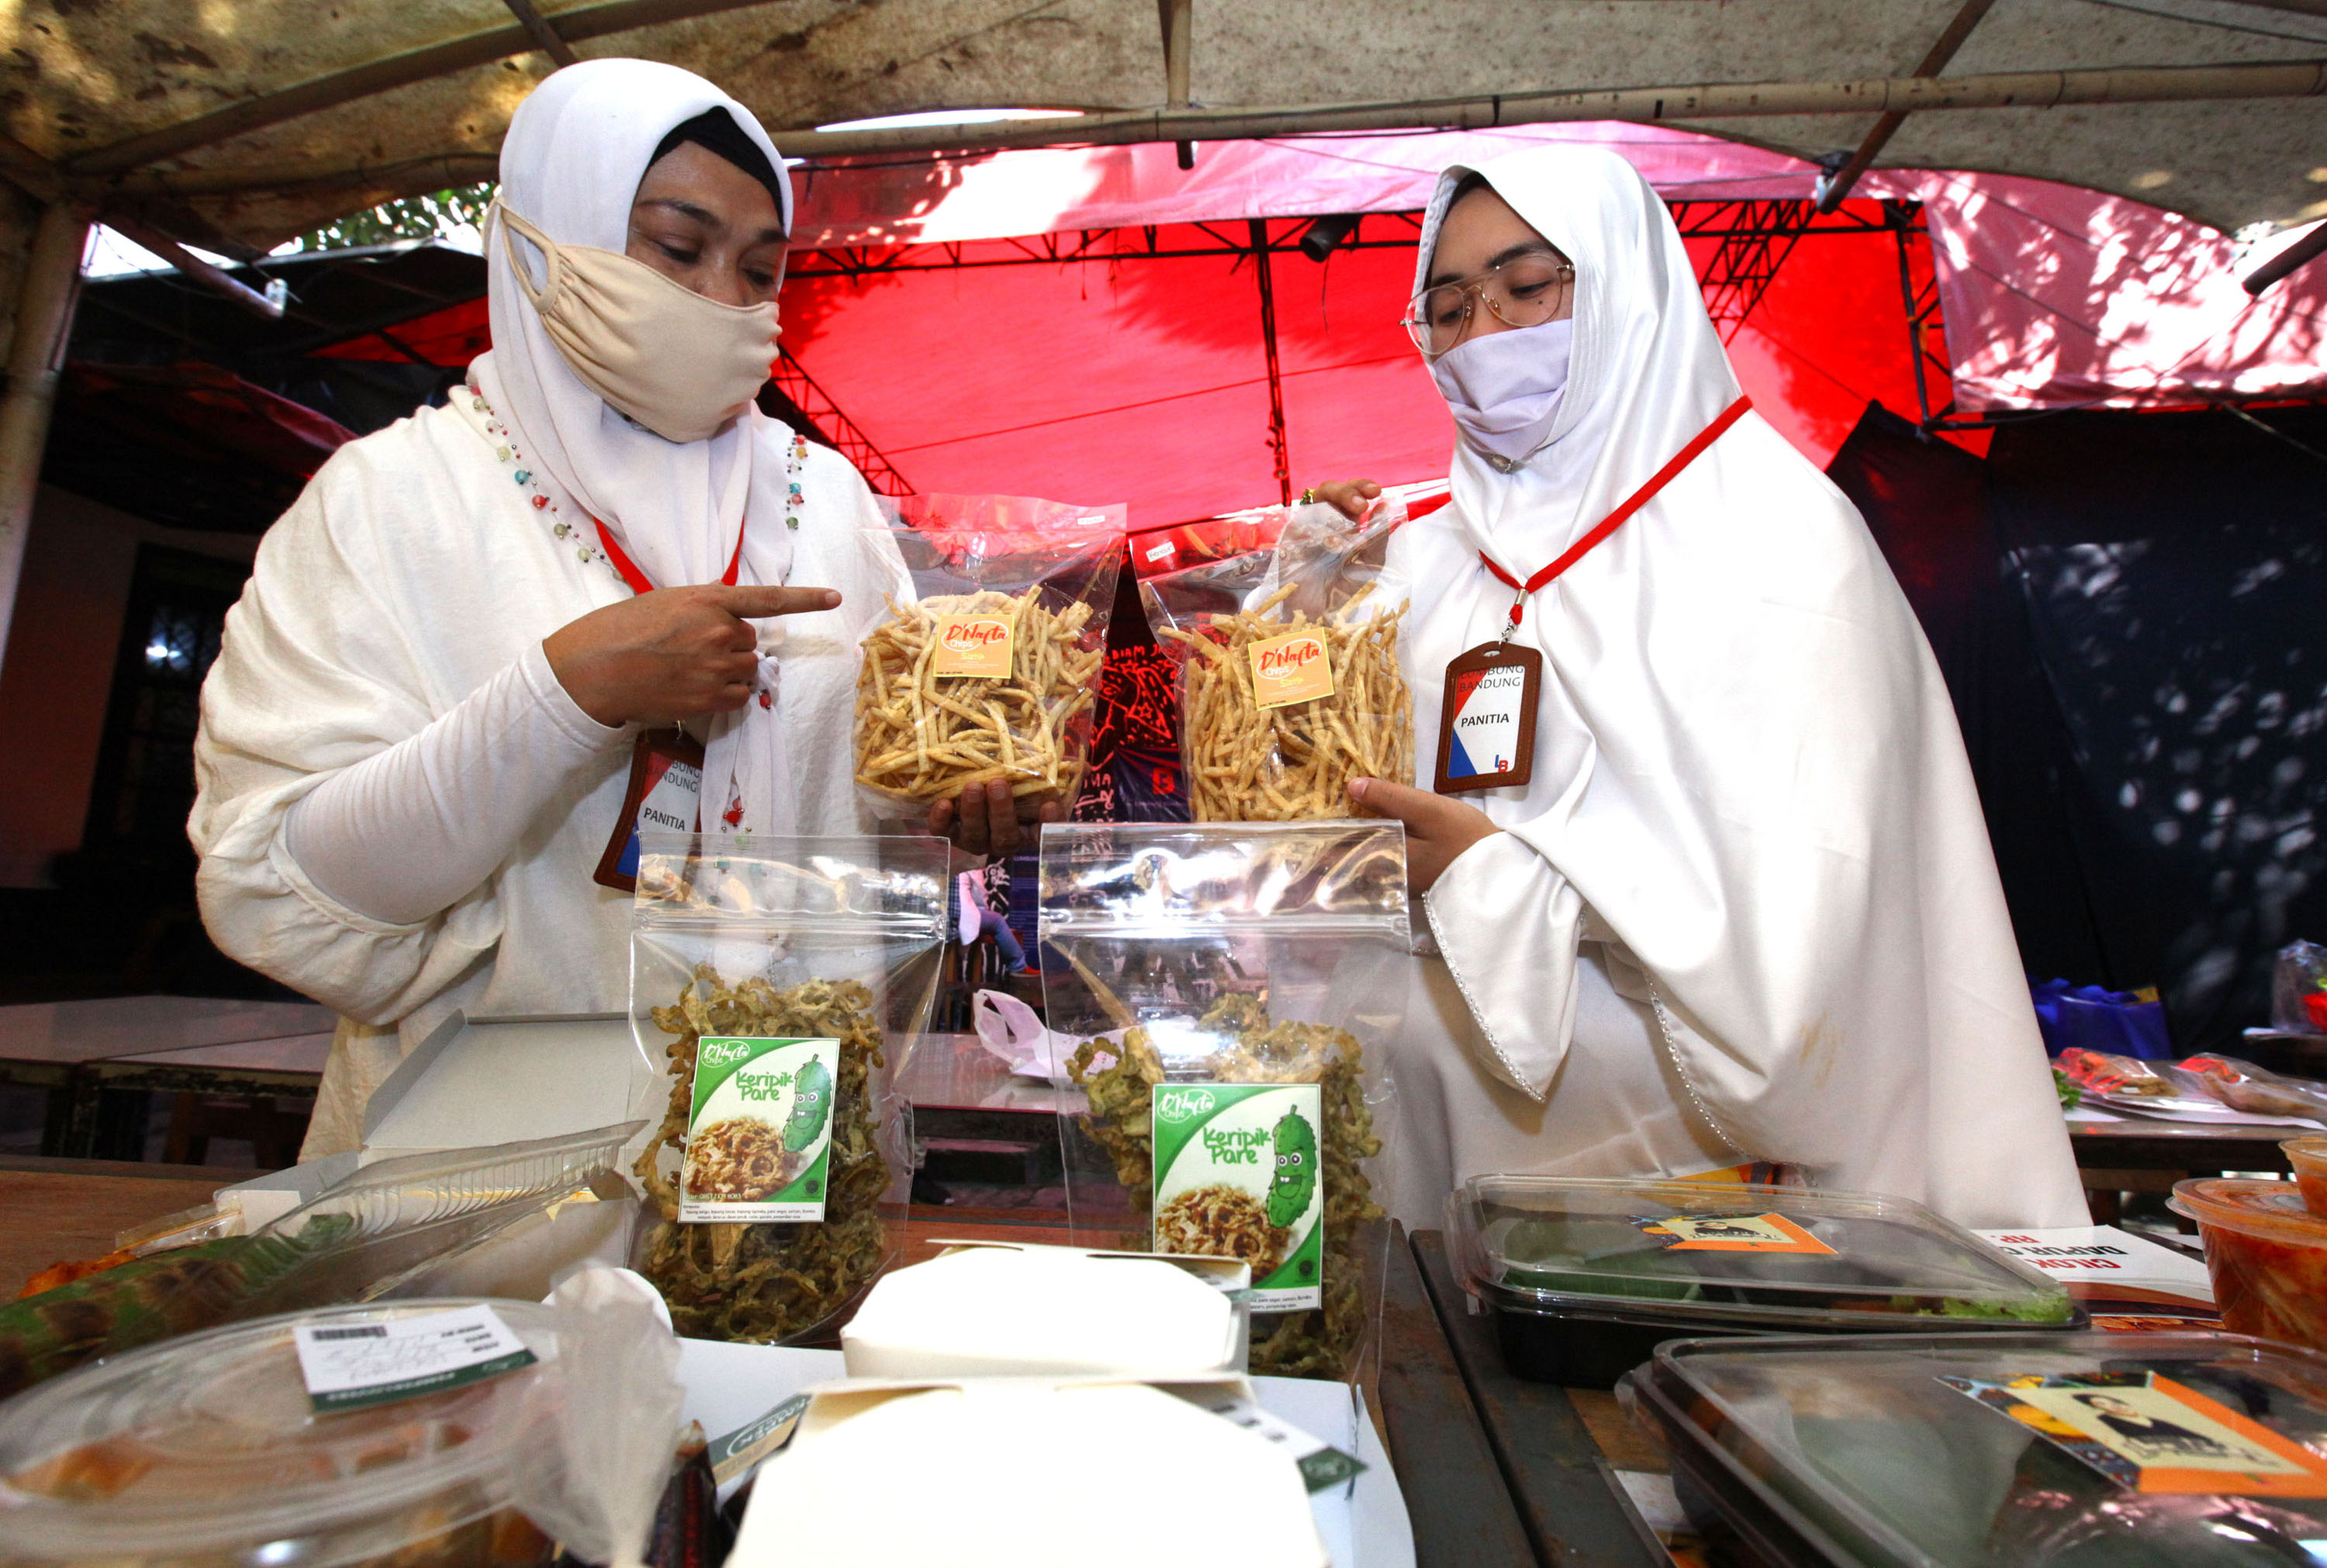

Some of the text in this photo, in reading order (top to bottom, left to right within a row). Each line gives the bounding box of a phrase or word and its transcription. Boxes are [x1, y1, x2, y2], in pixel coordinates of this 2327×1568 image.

[946, 623, 1006, 645] D'Nafta
[950, 639, 973, 649] Chips
[1261, 642, 1320, 670] D'Nafta
[1460, 677, 1520, 692] BANDUNG
[1461, 713, 1509, 727] PANITIA
[1495, 755, 1509, 772] LB
[644, 807, 686, 831] PANITIA
[736, 1071, 794, 1090] Keripik
[741, 1086, 780, 1101] Pare
[1204, 1127, 1272, 1149] Keripik
[1212, 1145, 1258, 1165] Pare
[2025, 1246, 2128, 1255] DAPUR
[2024, 1259, 2121, 1269] CILOK
